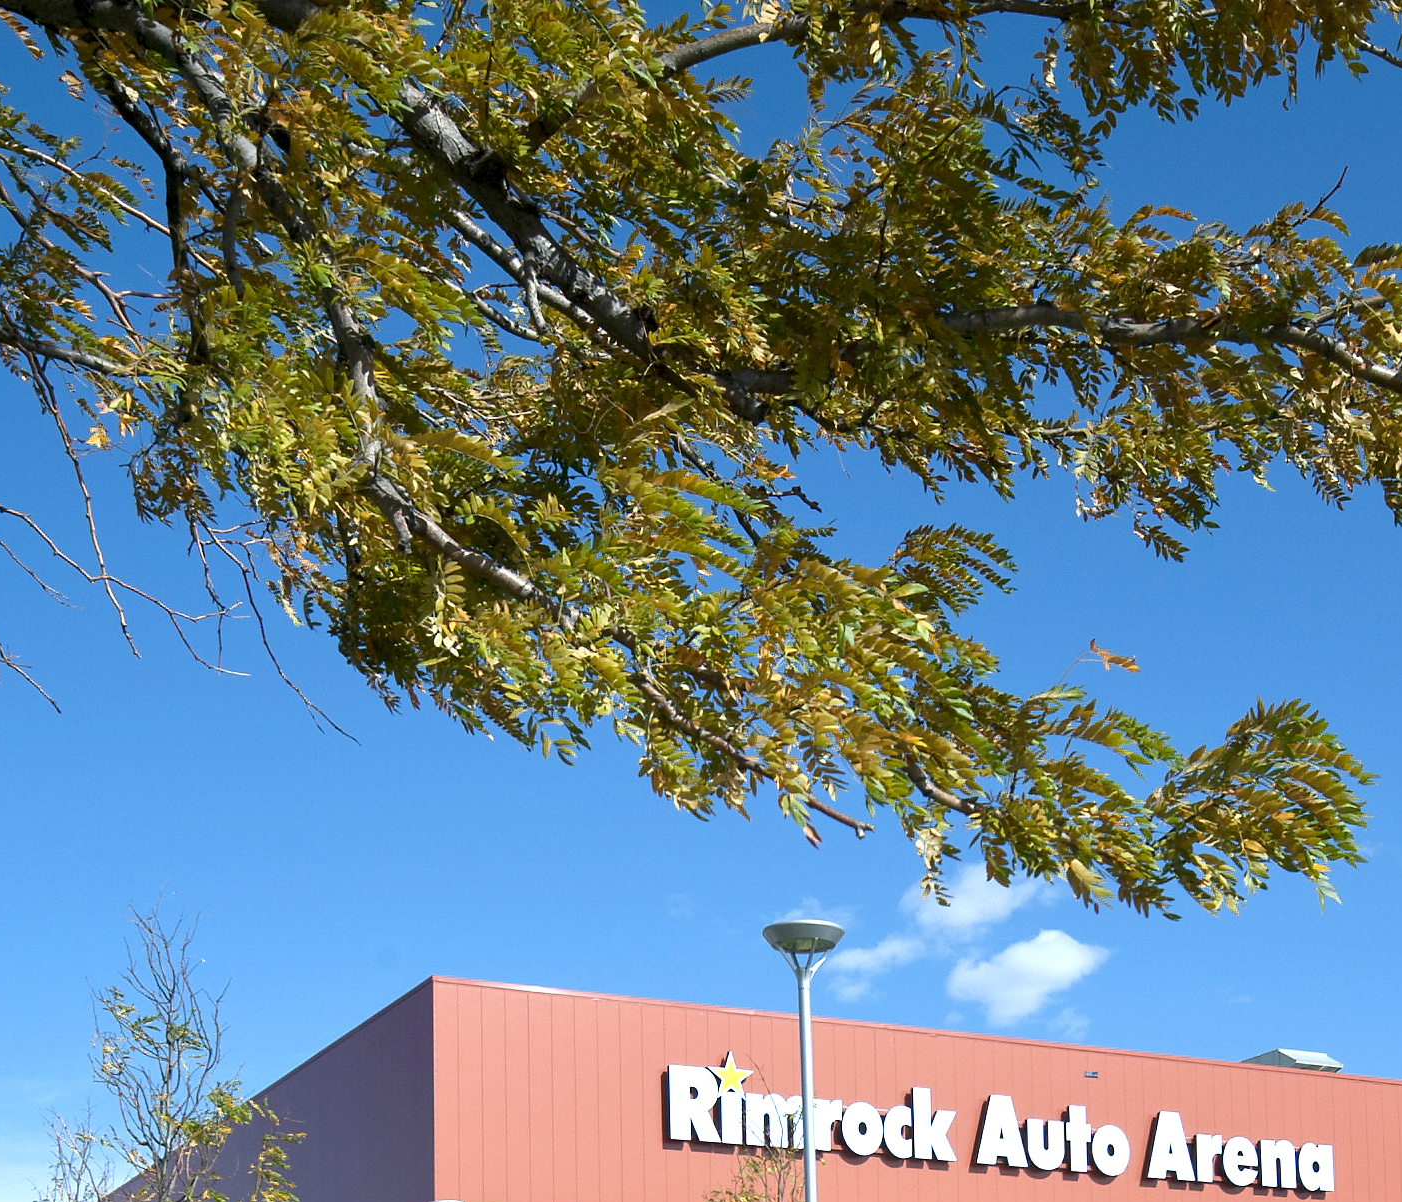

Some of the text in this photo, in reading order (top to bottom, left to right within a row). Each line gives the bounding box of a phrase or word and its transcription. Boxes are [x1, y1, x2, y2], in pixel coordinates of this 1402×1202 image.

[667, 1050, 1336, 1193] Rimrock Auto Arena
